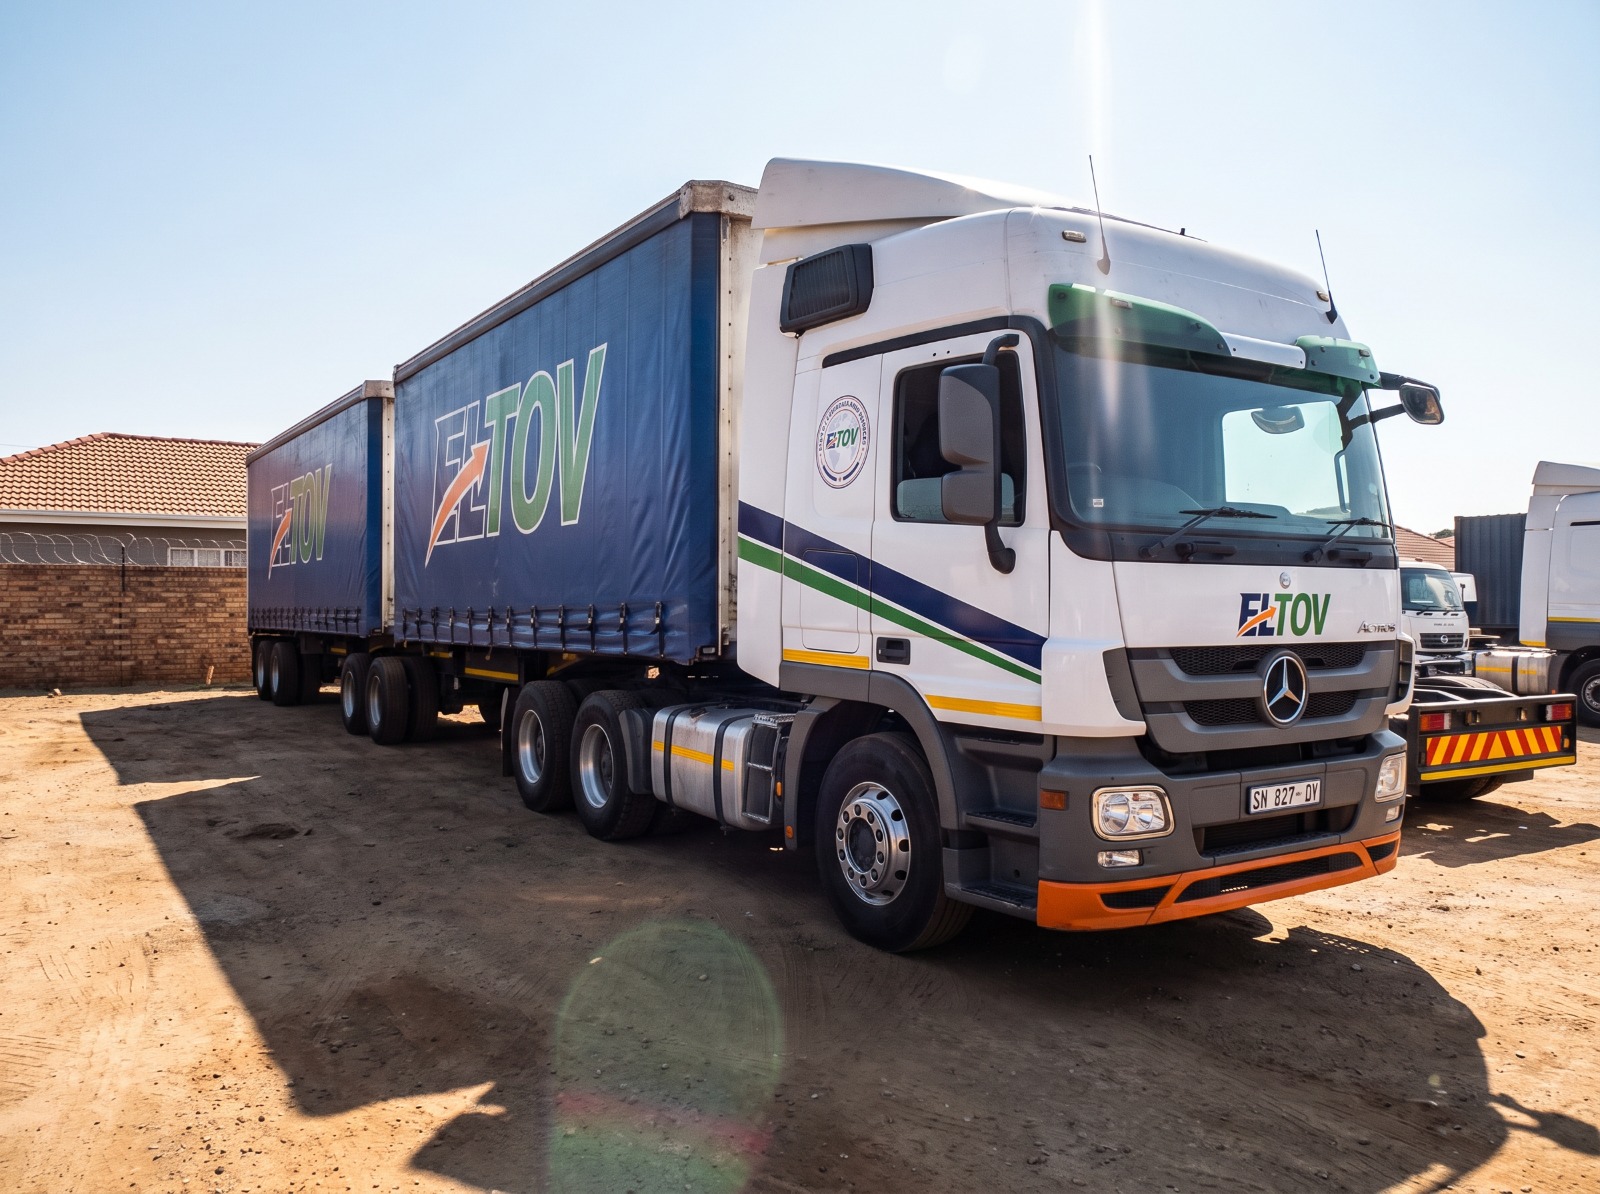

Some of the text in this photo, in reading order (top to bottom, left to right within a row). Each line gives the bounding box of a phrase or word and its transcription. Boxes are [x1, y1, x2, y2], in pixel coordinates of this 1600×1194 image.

[431, 342, 608, 547] ELTOV
[270, 463, 333, 568] ELTOV
[1237, 592, 1331, 637] ELTOV
[1252, 783, 1318, 810] SN 827 DY
